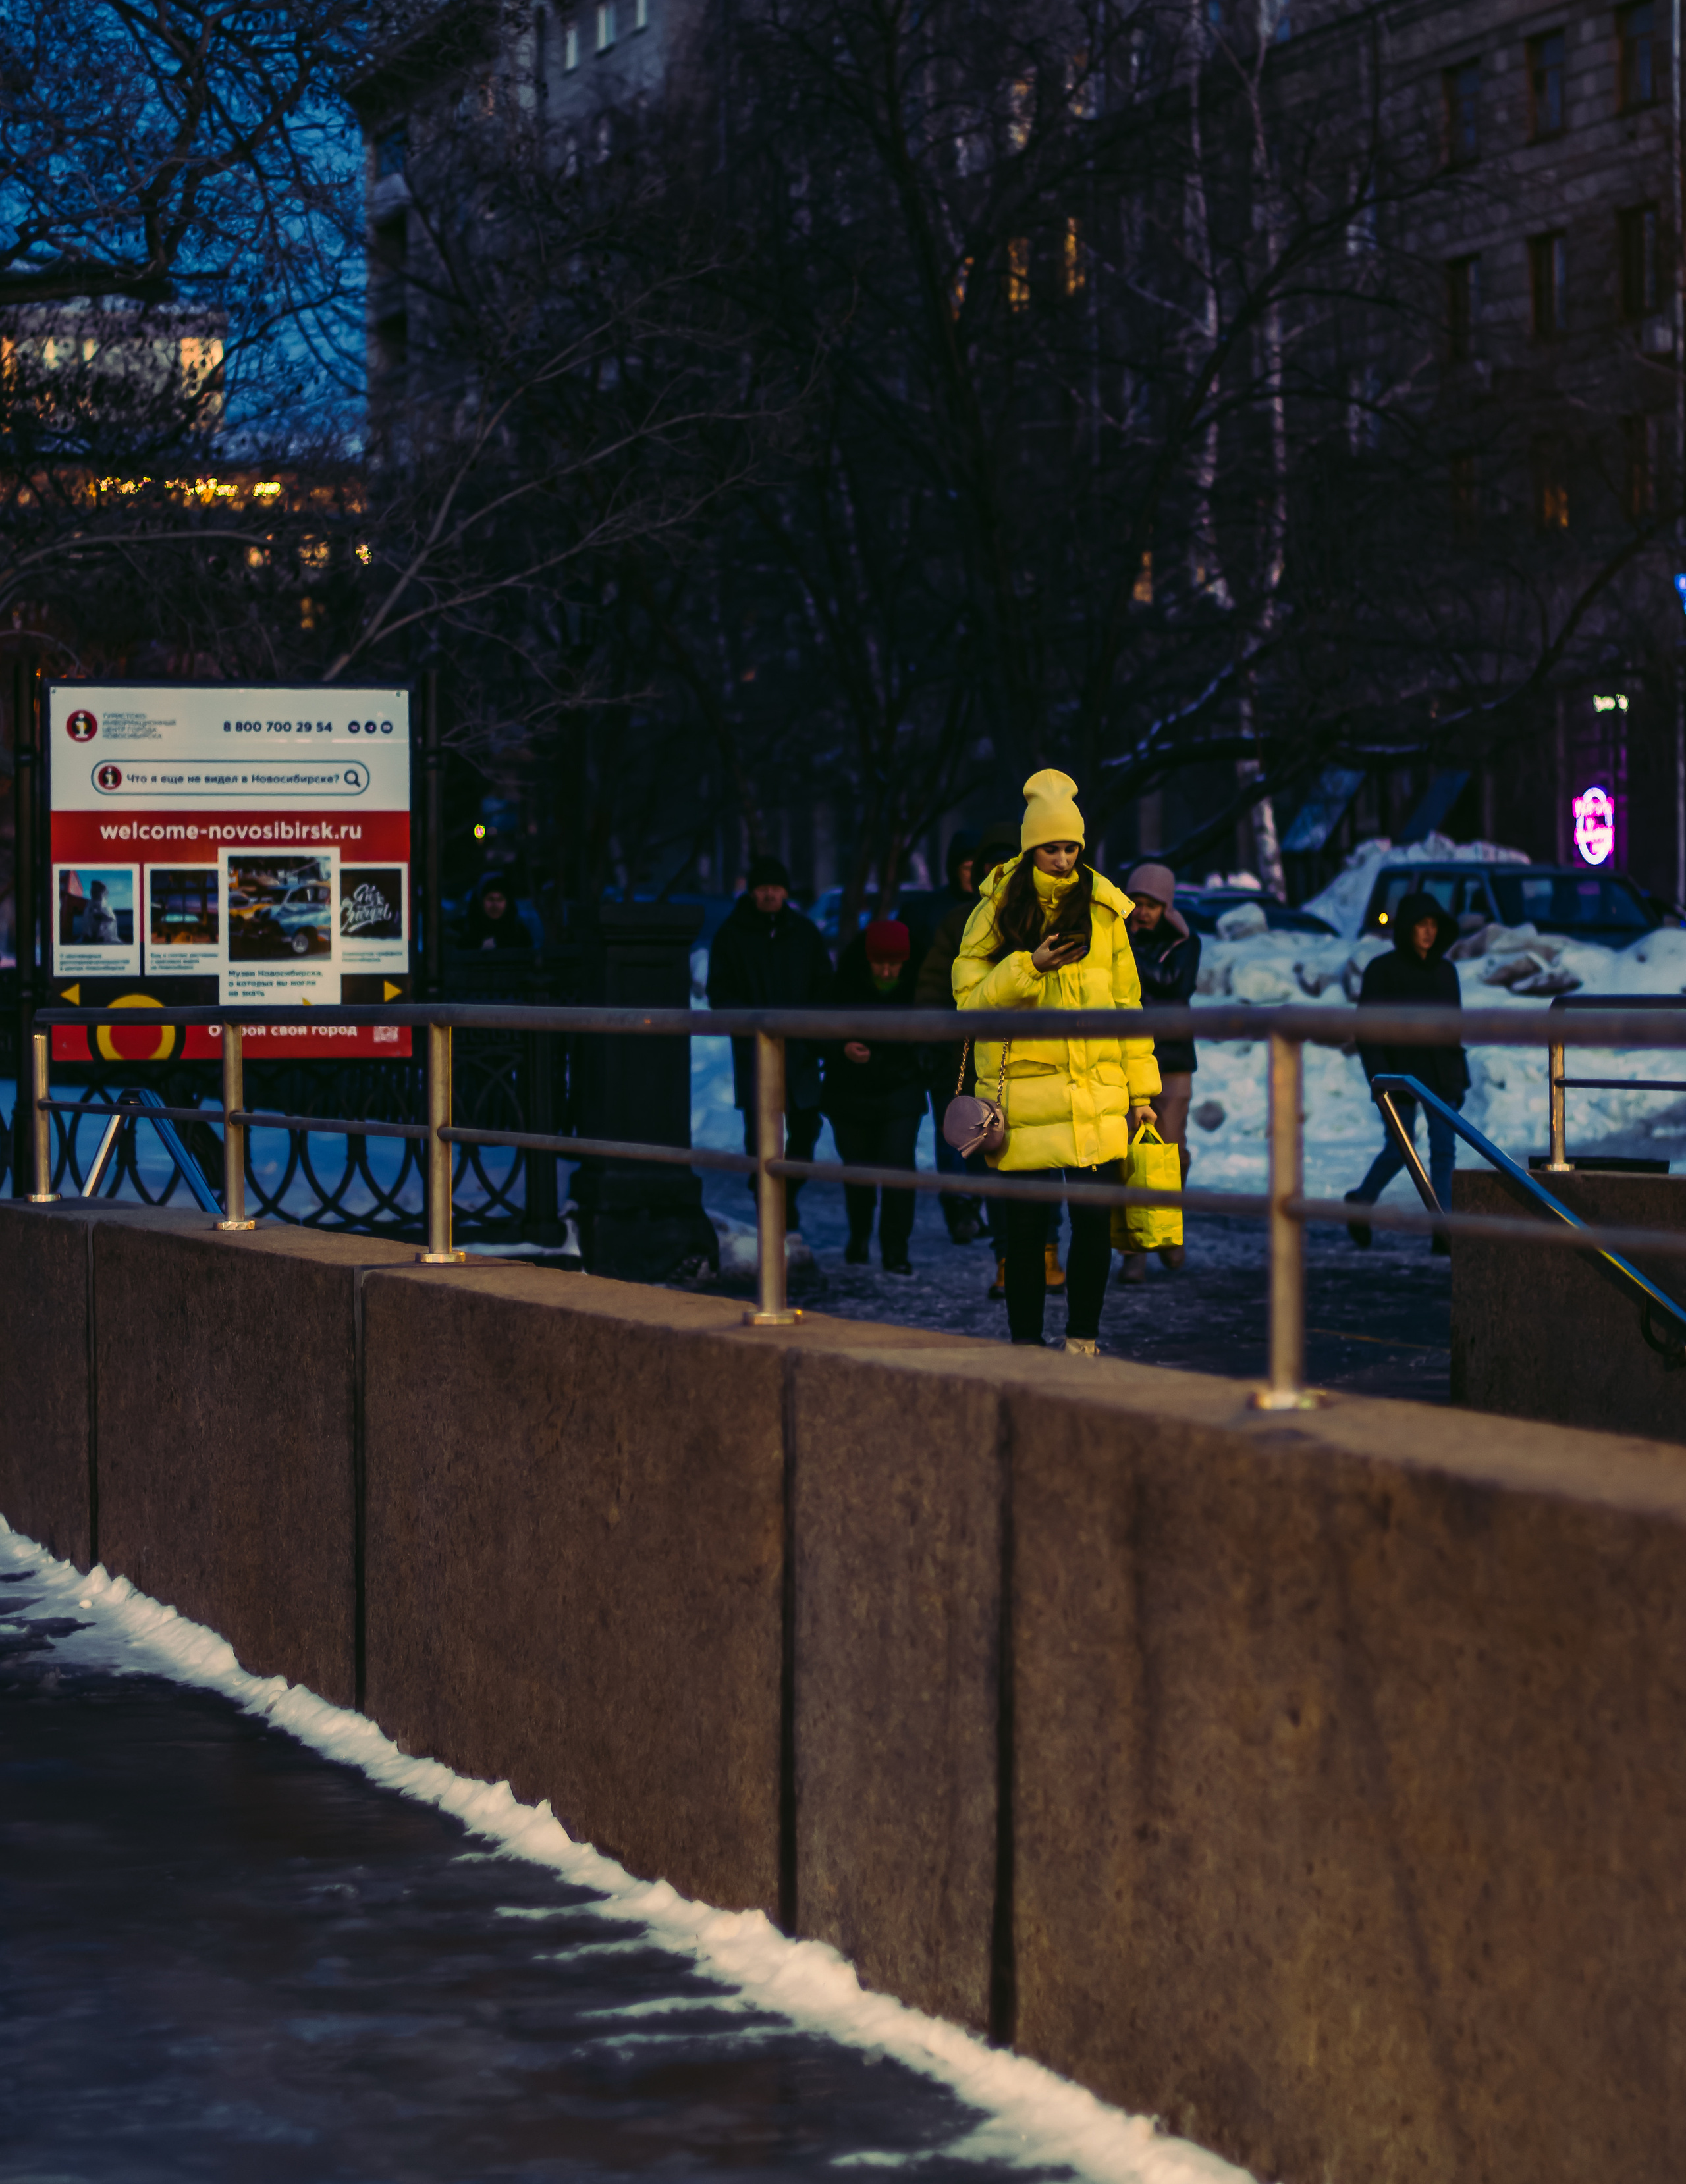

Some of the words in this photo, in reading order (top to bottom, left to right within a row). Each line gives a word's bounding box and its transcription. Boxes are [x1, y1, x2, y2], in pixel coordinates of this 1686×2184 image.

[223, 721, 231, 732] 8
[236, 721, 261, 732] 800
[267, 721, 292, 732] 700
[296, 722, 312, 732] 29
[316, 721, 332, 732] 54
[127, 774, 148, 783] Что
[161, 776, 184, 784] еще
[205, 776, 238, 784] видел
[252, 774, 339, 784] Новосибирске?
[100, 821, 362, 839] welcome-novosibirsk.ru
[208, 1025, 266, 1037] Орой
[312, 1025, 358, 1037] город
